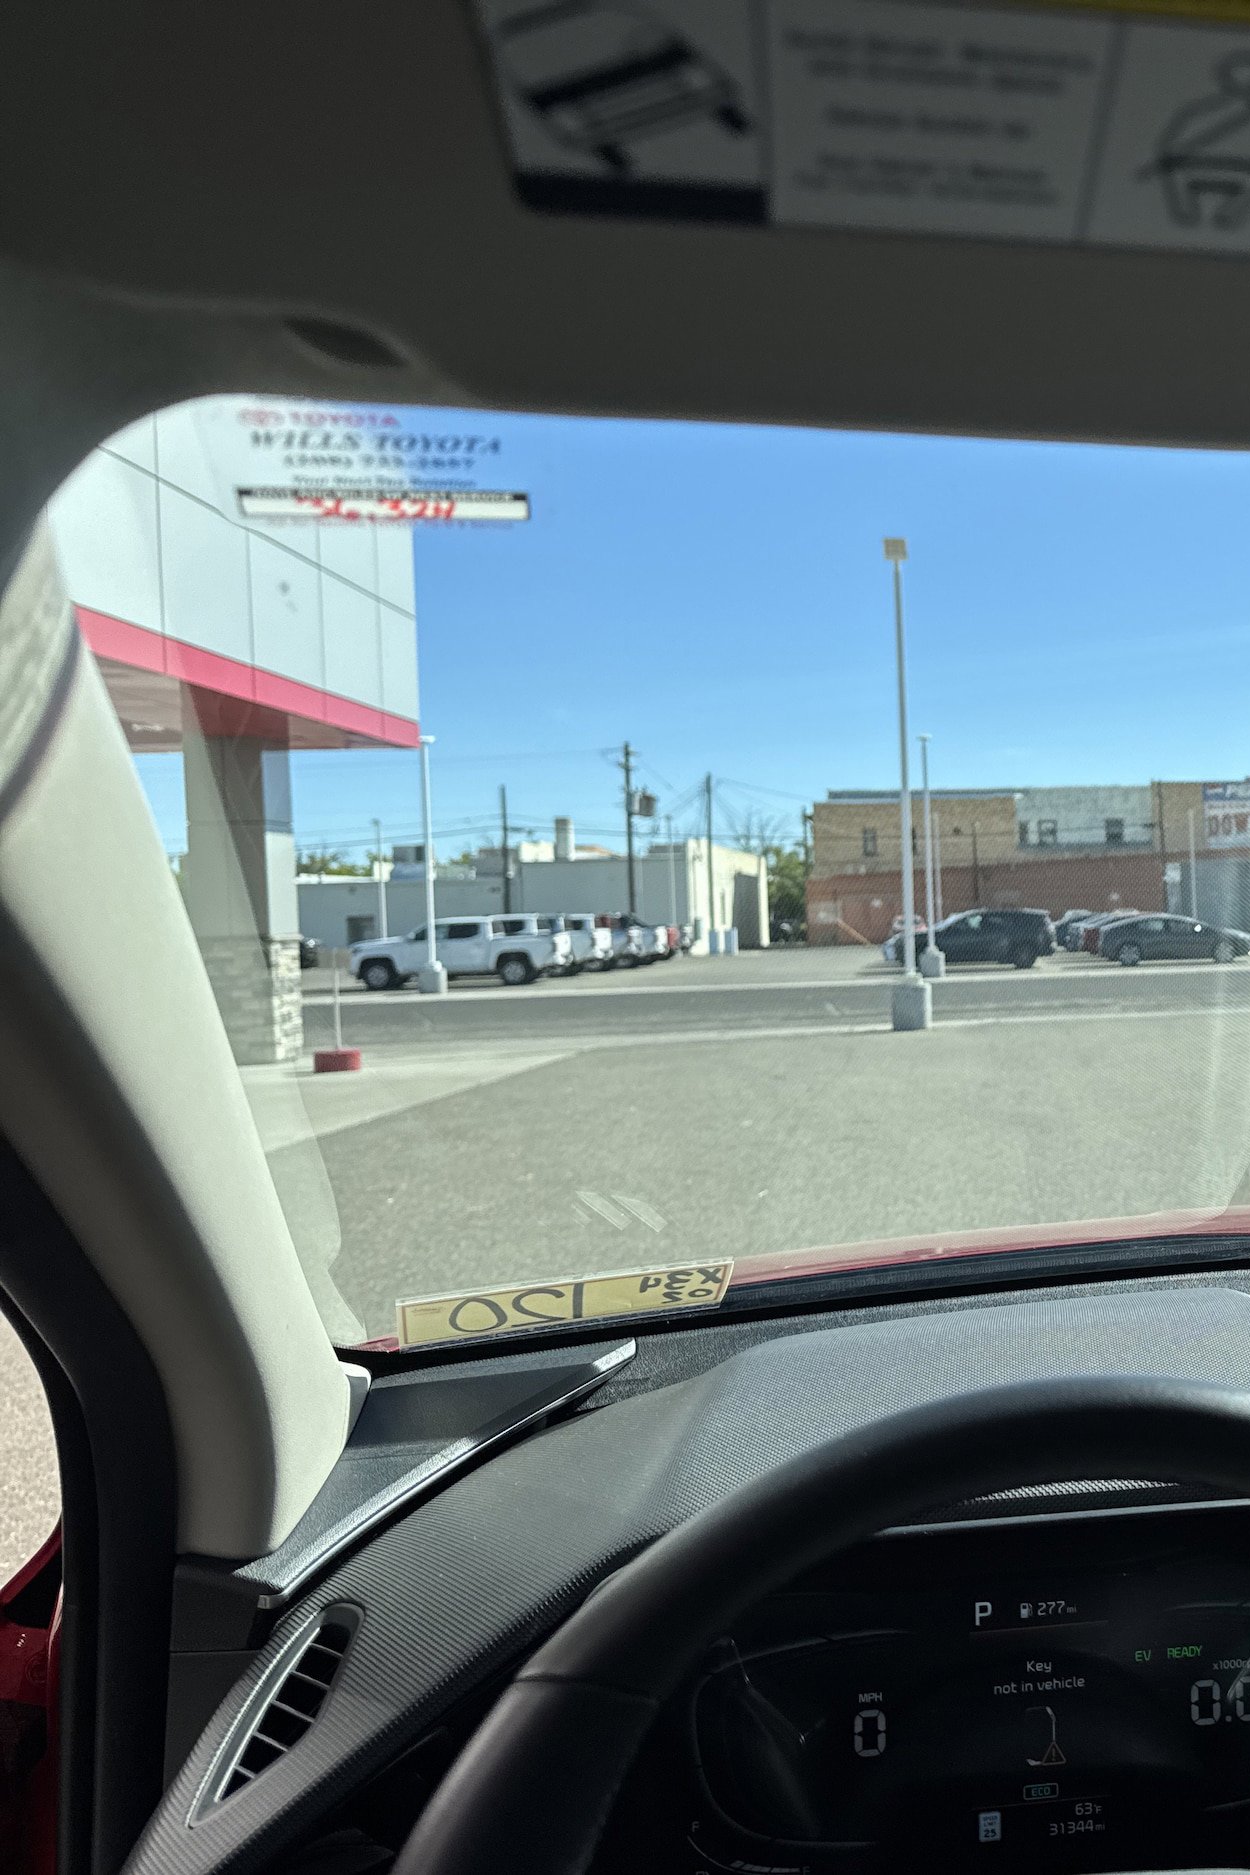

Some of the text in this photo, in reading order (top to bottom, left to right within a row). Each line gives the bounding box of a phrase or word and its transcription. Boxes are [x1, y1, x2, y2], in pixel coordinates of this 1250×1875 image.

[291, 410, 400, 427] TOYOTA
[250, 430, 502, 455] WILLS TOYOTA
[975, 1602, 992, 1627] P
[1037, 1601, 1065, 1616] 277
[1135, 1645, 1202, 1662] EV READY
[1026, 1661, 1052, 1673] Key
[994, 1677, 1086, 1695] not in vehicle
[859, 1692, 883, 1703] MPH
[854, 1709, 886, 1757] 0
[1031, 1787, 1051, 1797] ECO
[691, 1821, 700, 1832] F
[984, 1829, 996, 1838] 25
[1049, 1820, 1093, 1836] 31344
